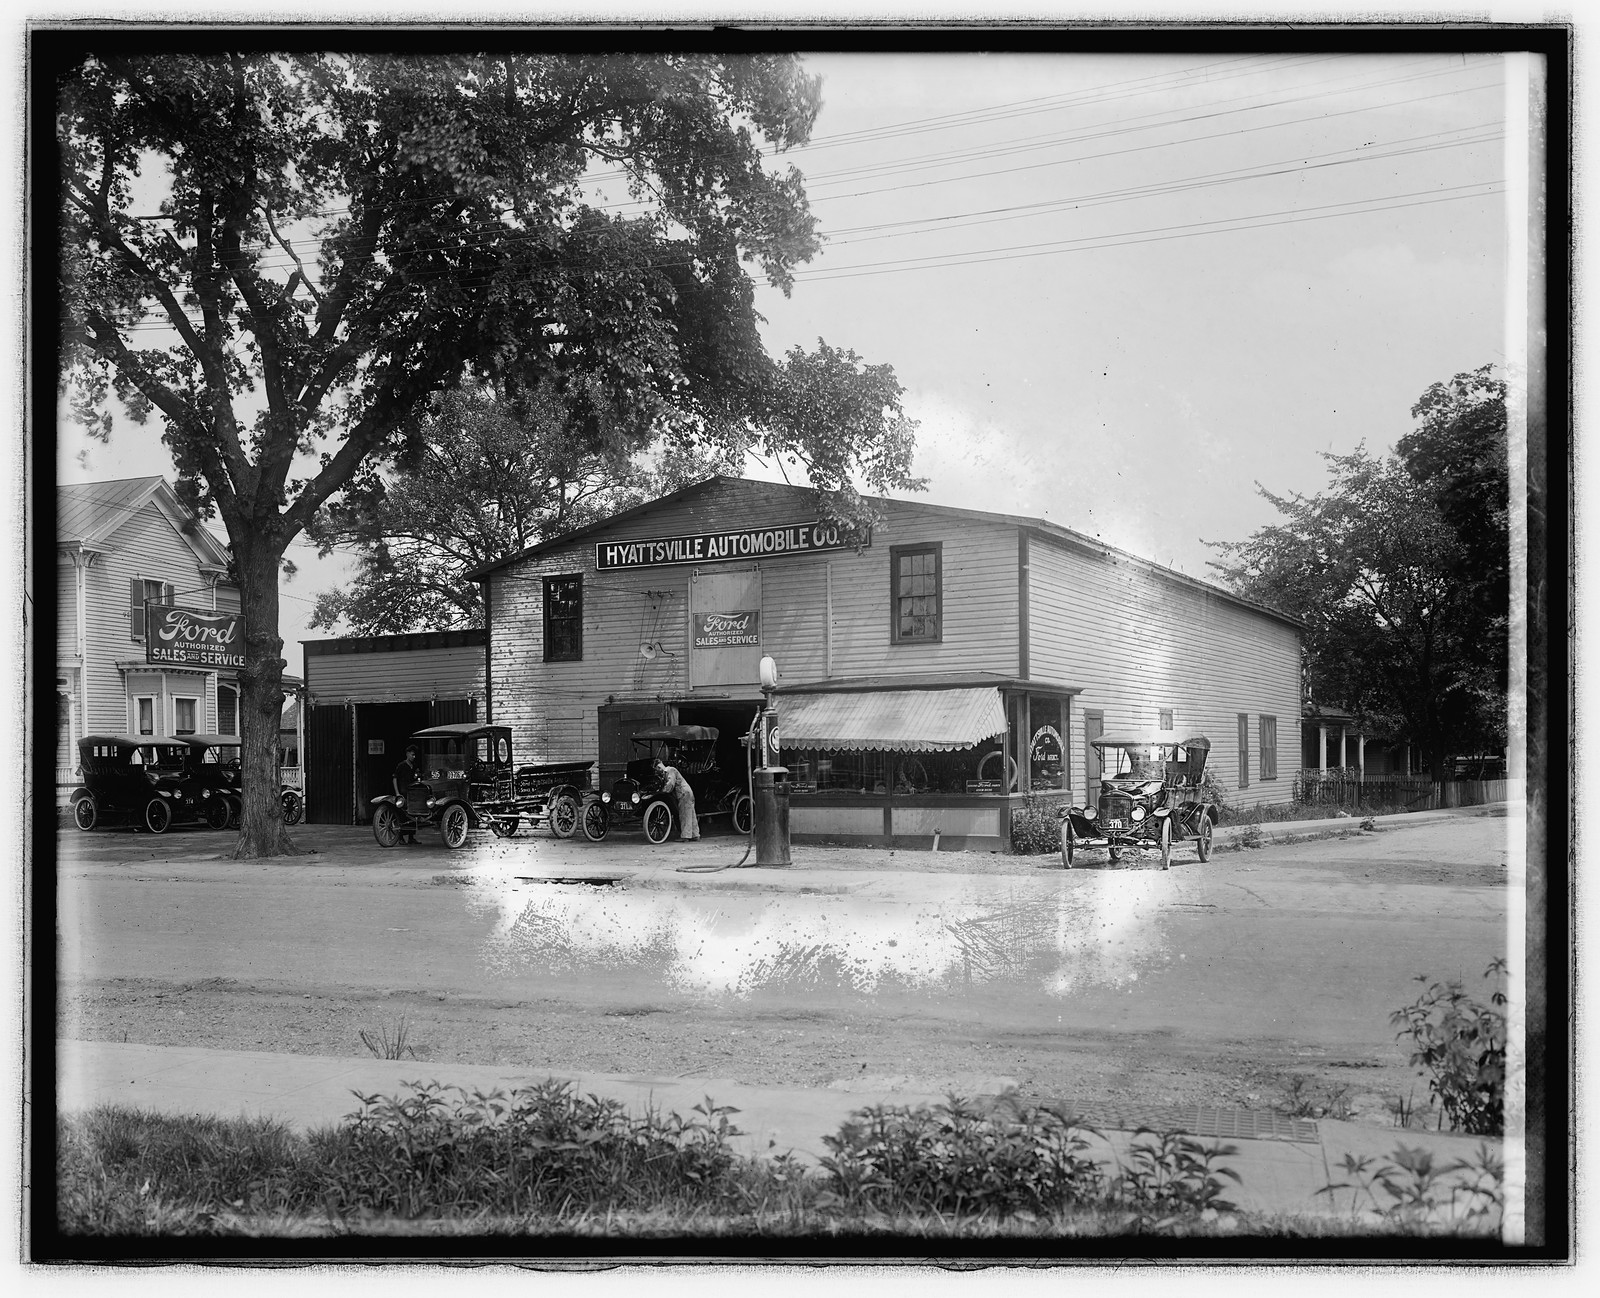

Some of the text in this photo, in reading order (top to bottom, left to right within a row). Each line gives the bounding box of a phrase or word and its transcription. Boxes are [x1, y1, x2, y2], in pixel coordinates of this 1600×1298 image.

[606, 538, 703, 565] HYATTSVILLE
[708, 527, 809, 558] AUTOMOBILE
[158, 611, 237, 644] Ford
[703, 613, 750, 633] Ford
[174, 641, 226, 652] AUTHORIZED
[695, 636, 719, 646] SALES
[727, 635, 758, 645] SERVICE
[152, 648, 245, 667] SALES AND SERVICE
[1033, 746, 1046, 761] Ford
